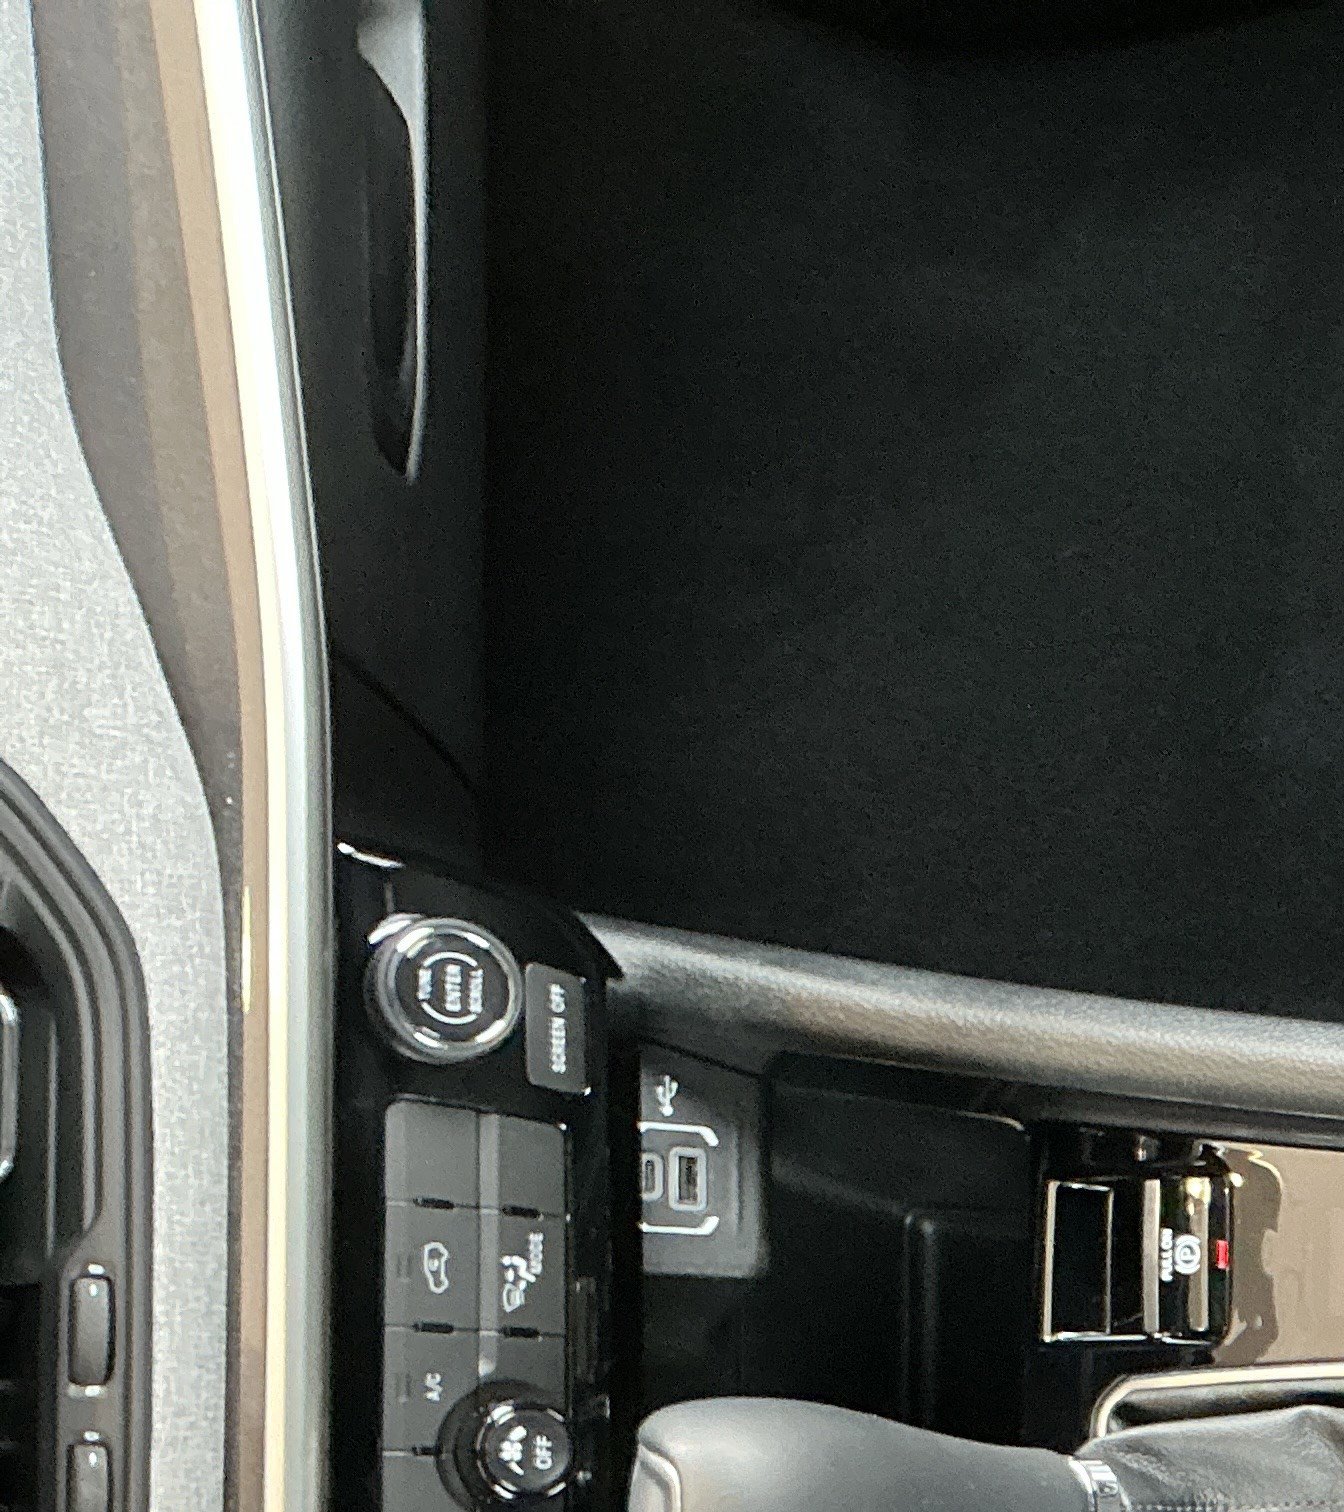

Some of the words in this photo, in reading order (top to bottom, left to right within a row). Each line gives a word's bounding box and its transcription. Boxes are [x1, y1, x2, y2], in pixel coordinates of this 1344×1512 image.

[445, 964, 461, 1012] ENTER
[550, 983, 566, 1013] OFF
[550, 1018, 566, 1074] SCREEN
[529, 1231, 544, 1275] MODE
[424, 1372, 443, 1402] A/C
[534, 1435, 553, 1470] OFF
